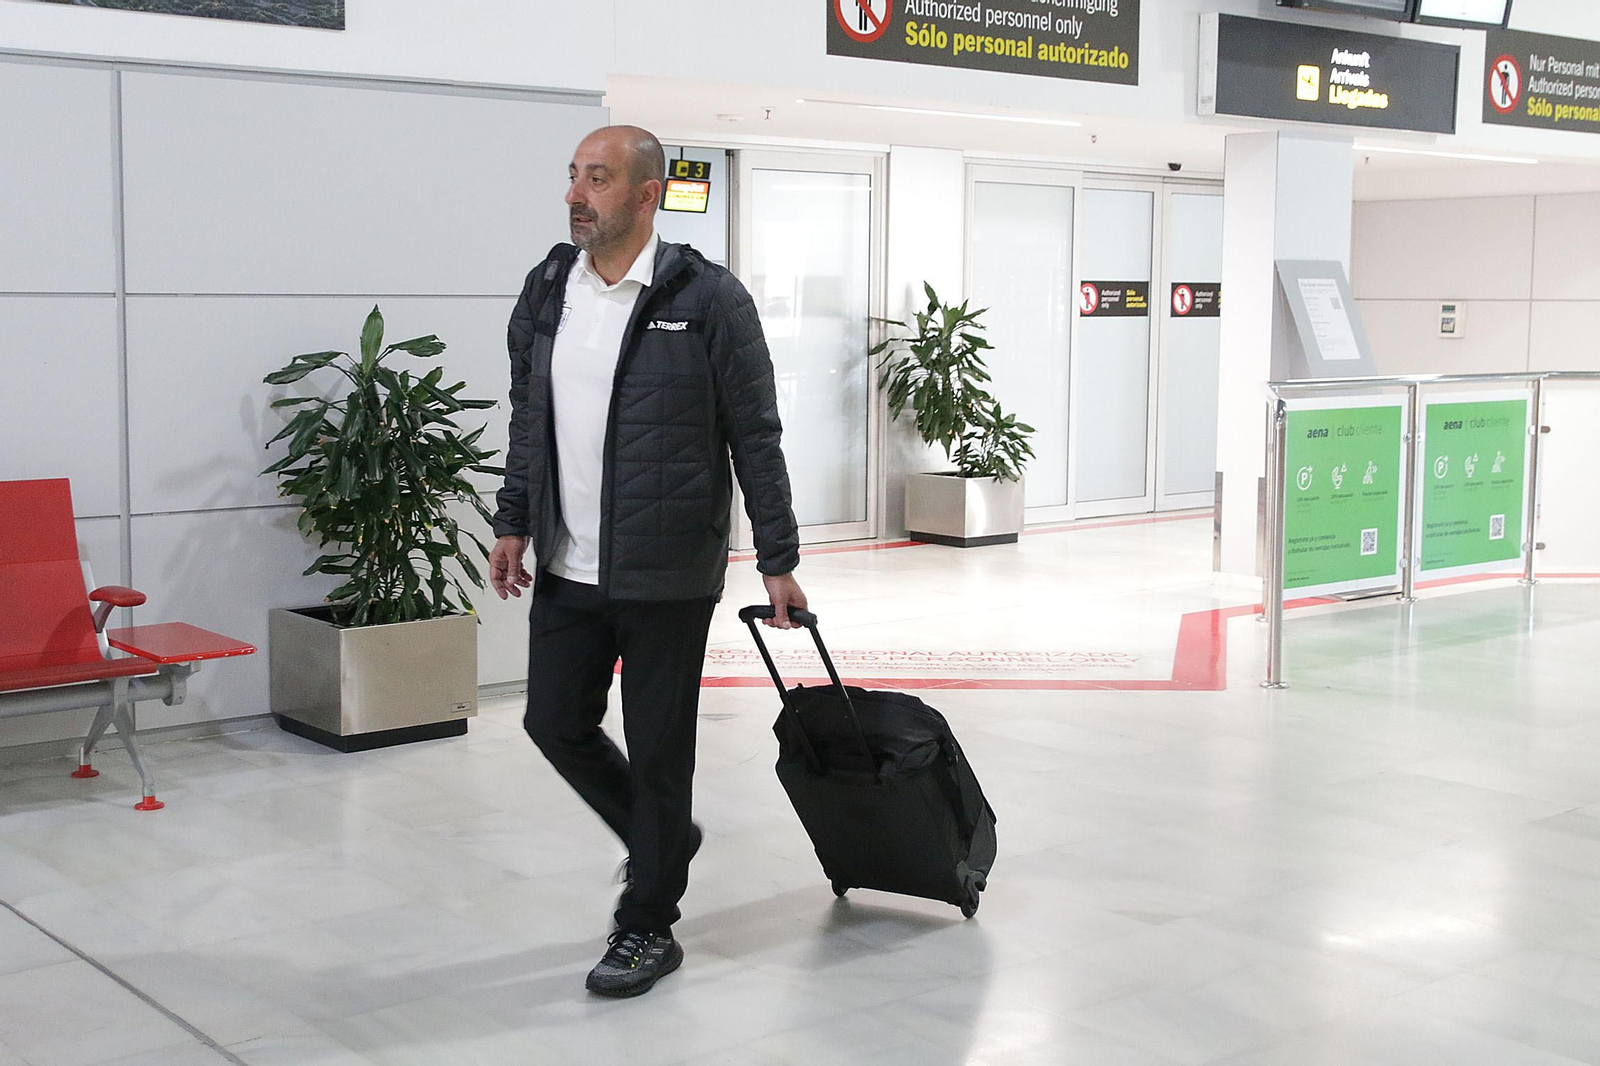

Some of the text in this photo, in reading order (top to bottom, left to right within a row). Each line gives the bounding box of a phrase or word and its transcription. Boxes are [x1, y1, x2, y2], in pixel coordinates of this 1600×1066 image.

[904, 0, 1083, 39] Authorized personnel only
[905, 21, 1129, 69] Sólo personal autorizado
[1529, 54, 1600, 79] Nur Personal mit
[1328, 84, 1389, 109] Llegadas
[1527, 75, 1574, 97] Authorized
[1527, 96, 1553, 117] Sólo
[694, 163, 704, 178] 3
[656, 320, 689, 331] TERREX
[1306, 428, 1329, 438] aena
[1443, 420, 1463, 430] aena
[948, 650, 1127, 658] AUTORIZADO
